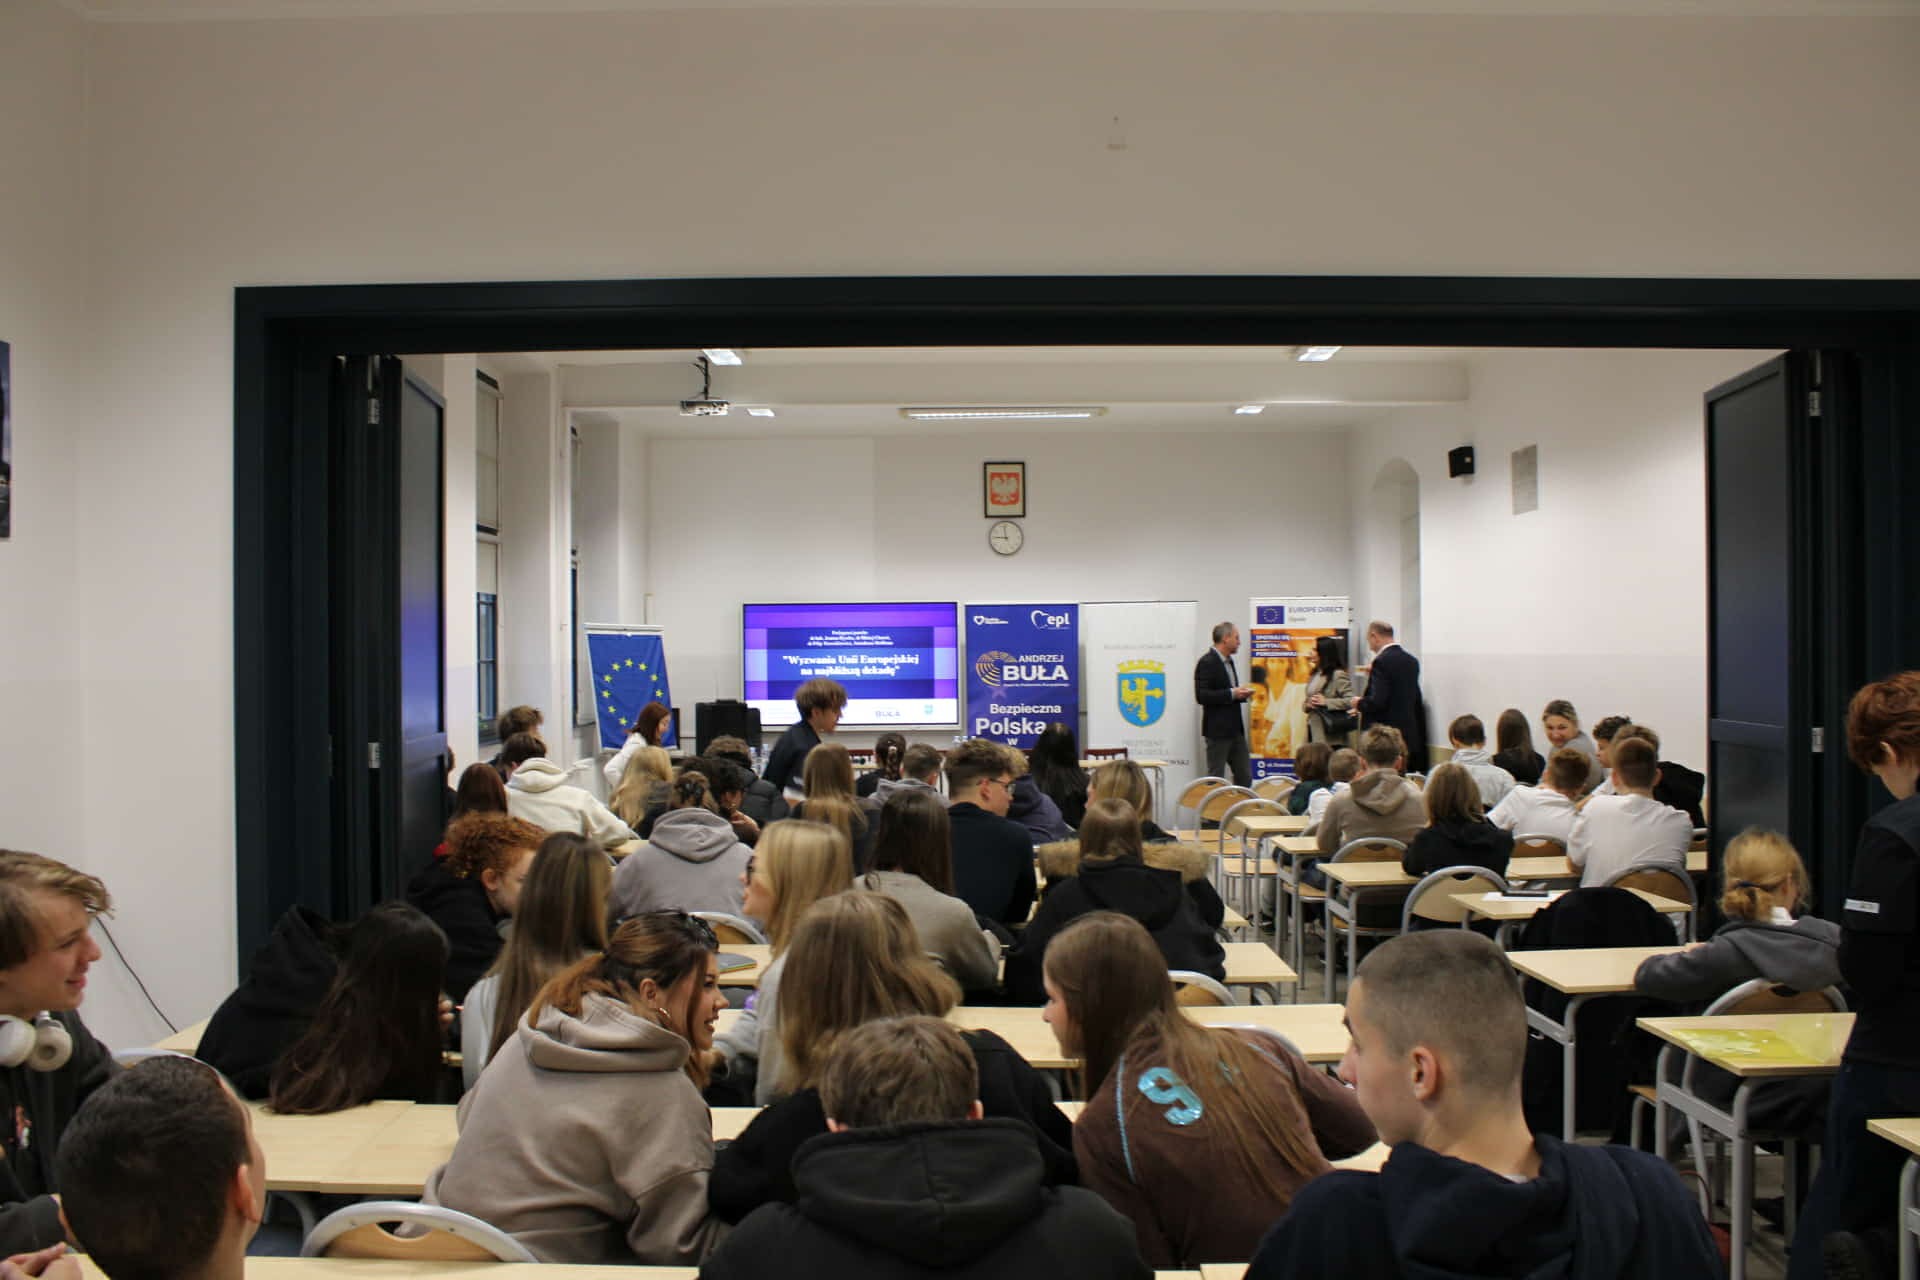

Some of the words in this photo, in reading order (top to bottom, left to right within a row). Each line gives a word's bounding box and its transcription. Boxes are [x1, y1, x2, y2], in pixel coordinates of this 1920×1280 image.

[1047, 613, 1070, 628] epl
[838, 655, 858, 664] Unii
[860, 655, 919, 665] Europejskiej
[1018, 654, 1064, 663] ANDRZEJ
[1003, 665, 1069, 681] BUŁA
[989, 703, 1062, 716] Bezpieczna
[975, 717, 1047, 735] Polska
